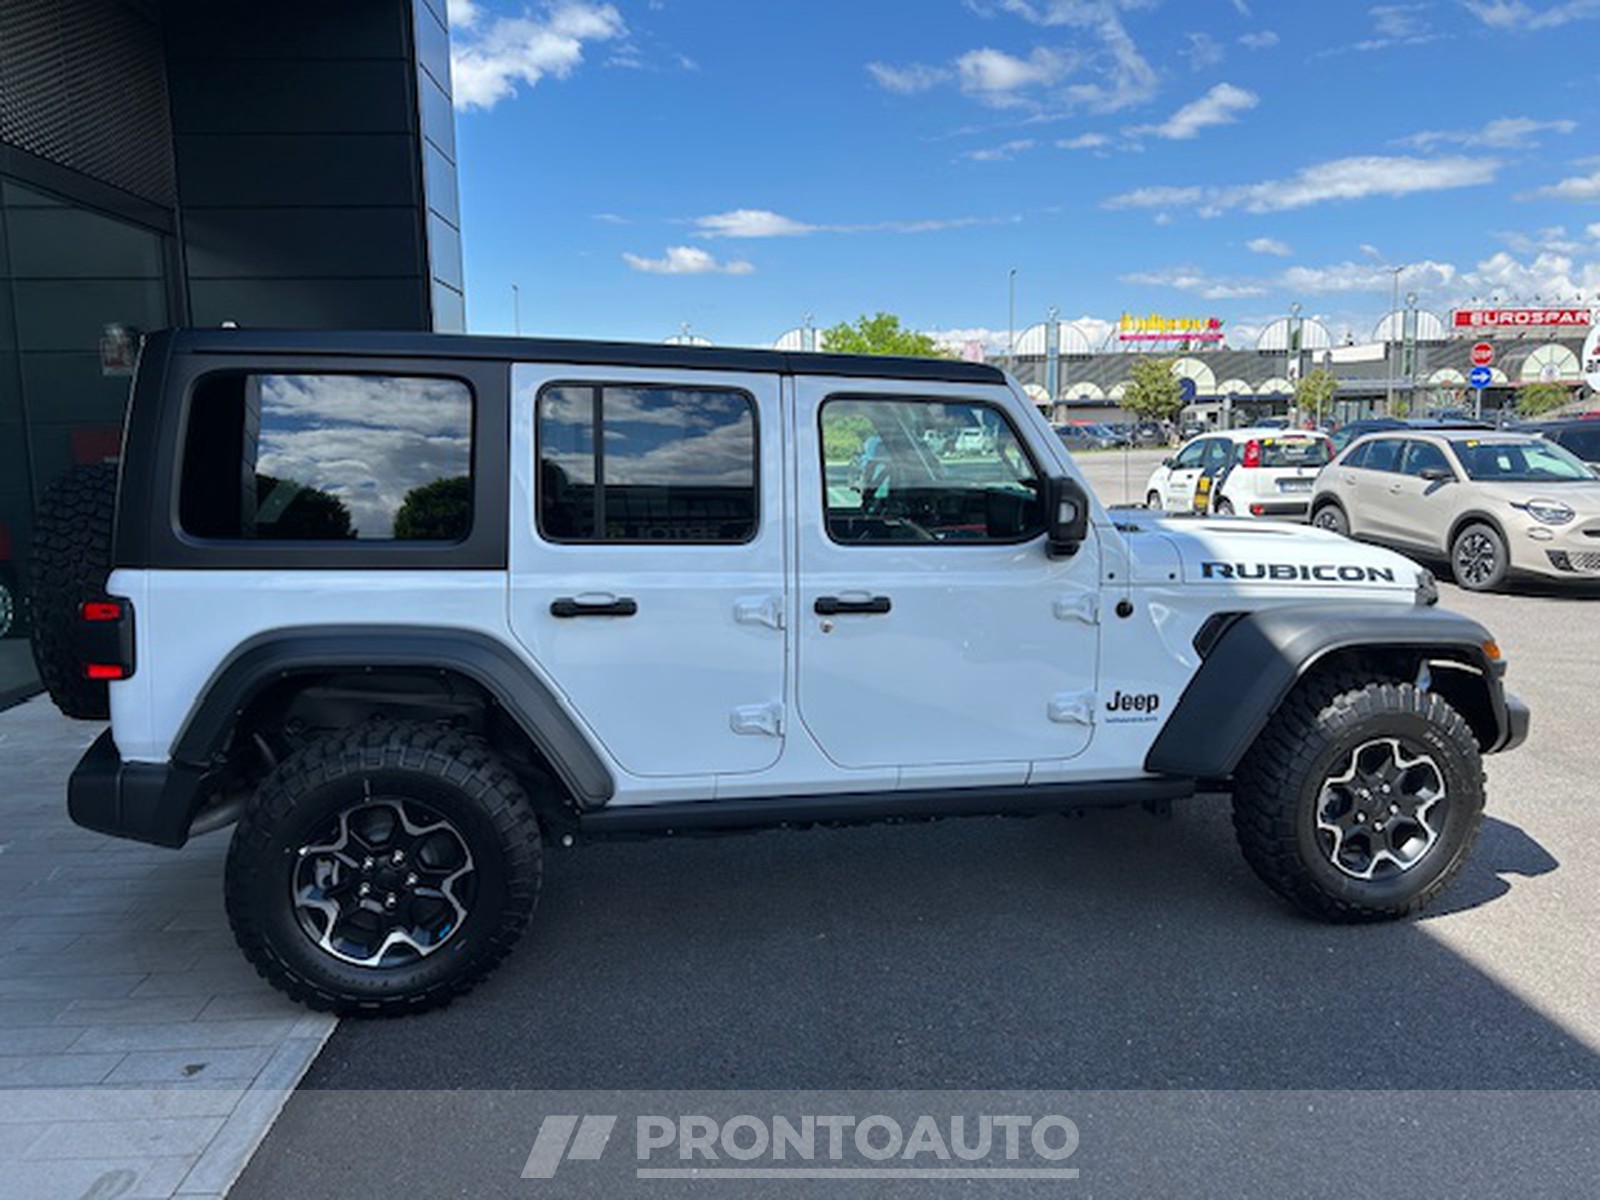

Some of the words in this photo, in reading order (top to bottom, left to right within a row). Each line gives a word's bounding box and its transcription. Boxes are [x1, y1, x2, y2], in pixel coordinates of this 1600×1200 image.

[1470, 311, 1590, 325] EUROSPAR
[1201, 562, 1395, 583] RUBICON
[1106, 690, 1159, 713] Jeep
